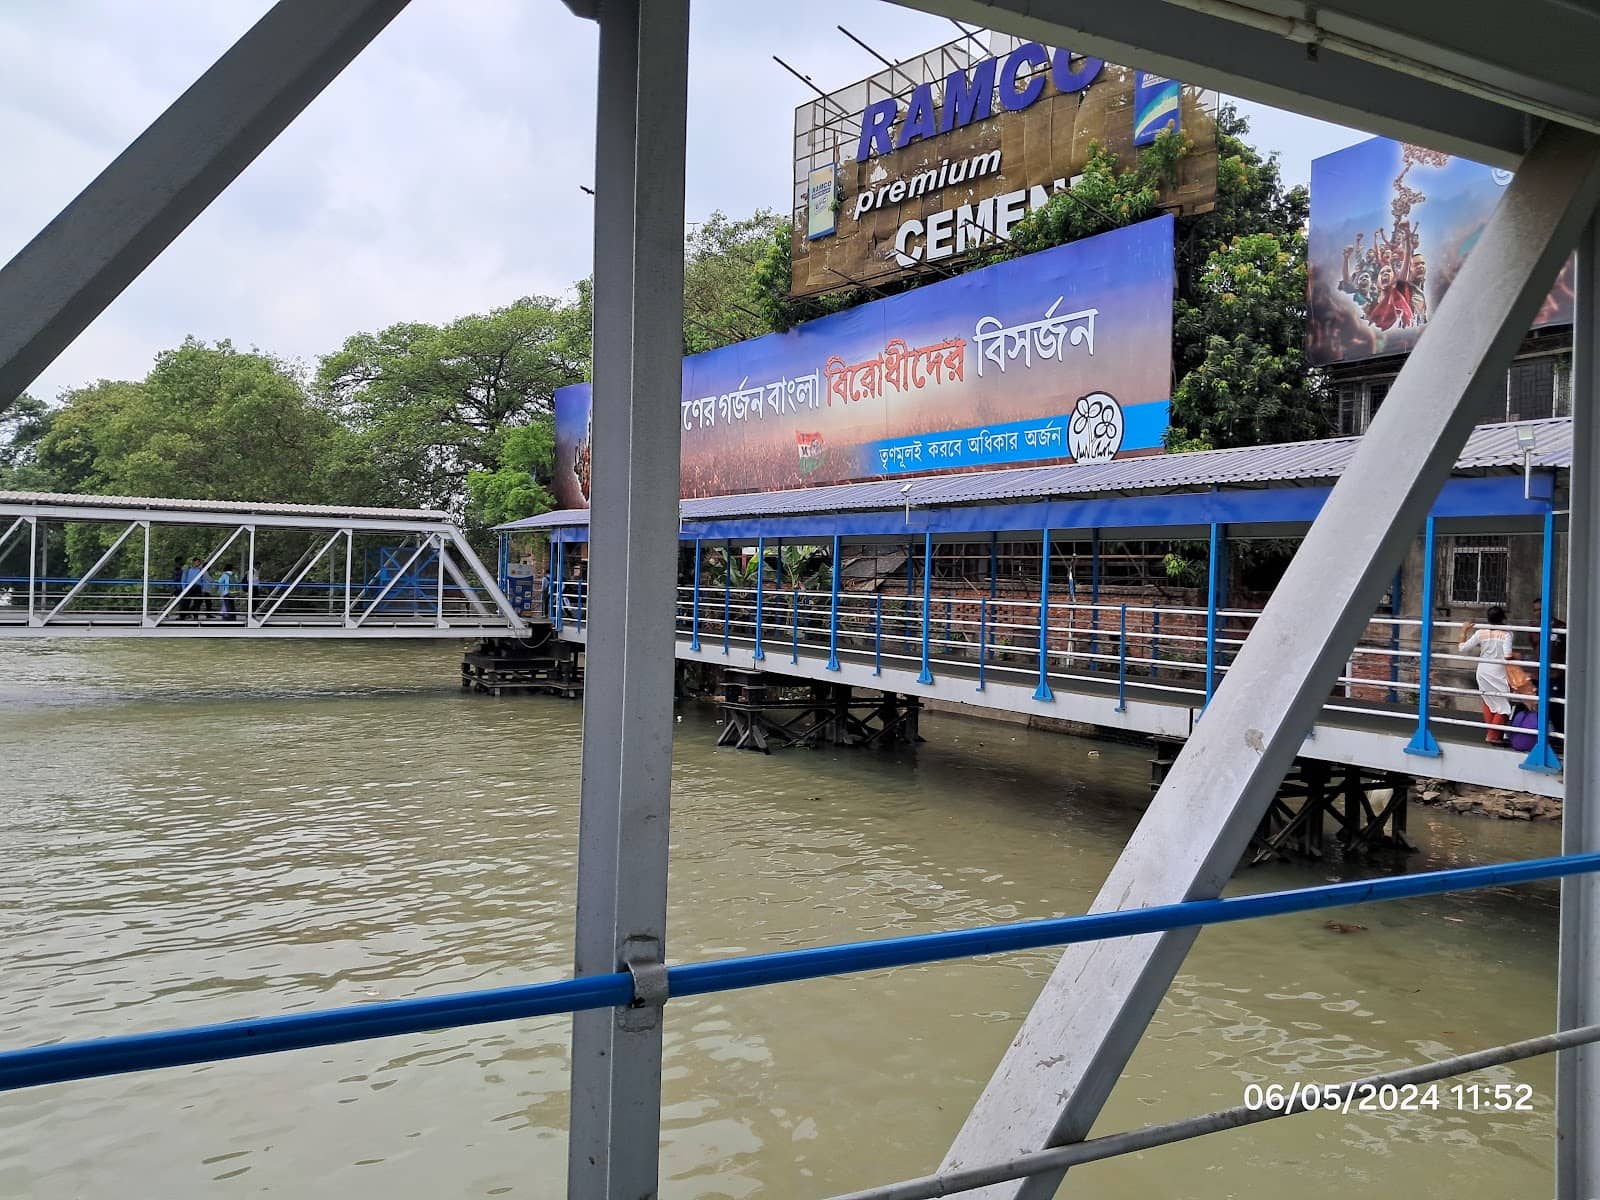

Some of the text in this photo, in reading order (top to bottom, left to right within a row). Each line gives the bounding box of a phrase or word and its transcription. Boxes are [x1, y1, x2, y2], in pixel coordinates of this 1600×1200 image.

[853, 149, 1002, 220] premium
[893, 174, 1083, 267] CEMEN
[718, 375, 765, 424] গর্জন
[767, 367, 819, 416] বাংলা
[824, 337, 967, 407] বিরোধীদের
[972, 296, 1099, 377] বিসর্জন
[879, 420, 1062, 471] তৃণমূলই করবে অধিকার অর্জন
